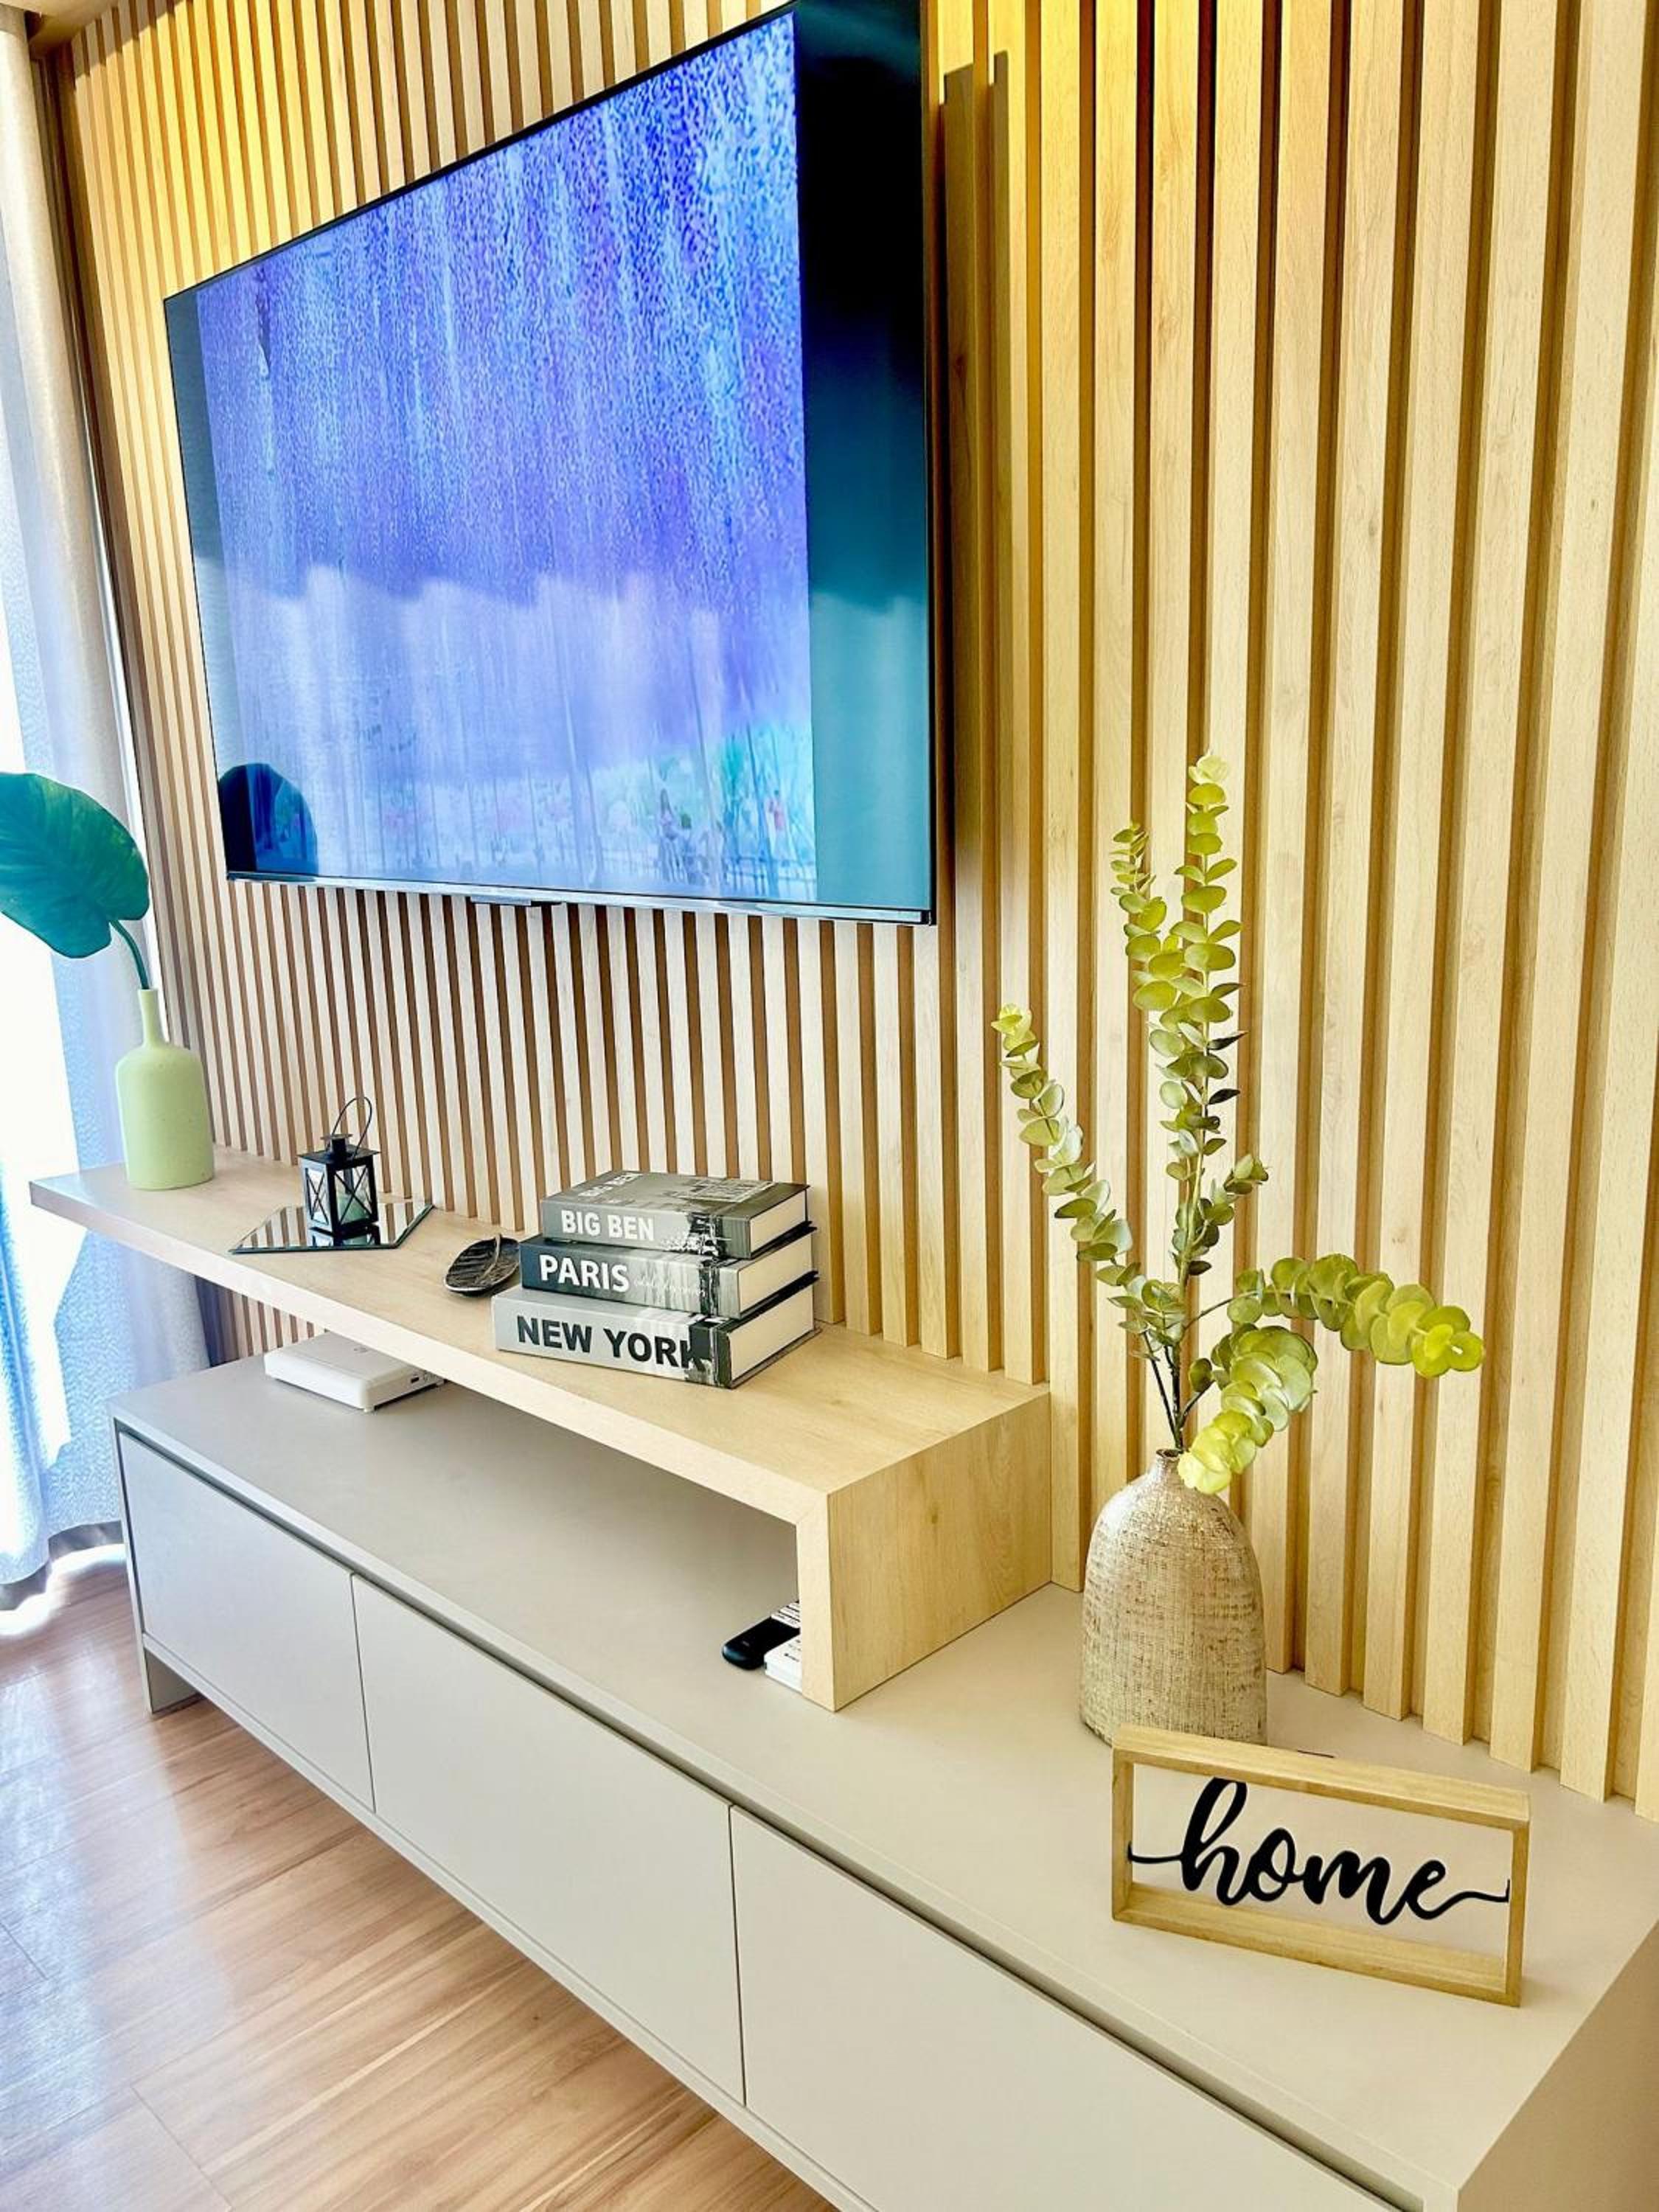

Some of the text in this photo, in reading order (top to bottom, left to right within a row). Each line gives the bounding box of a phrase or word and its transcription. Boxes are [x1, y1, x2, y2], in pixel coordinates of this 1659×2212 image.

[560, 1209, 655, 1241] BIG BEN
[538, 1254, 630, 1293] PARIS
[517, 1315, 706, 1372] NEW YORK
[1127, 1775, 1510, 1925] home
